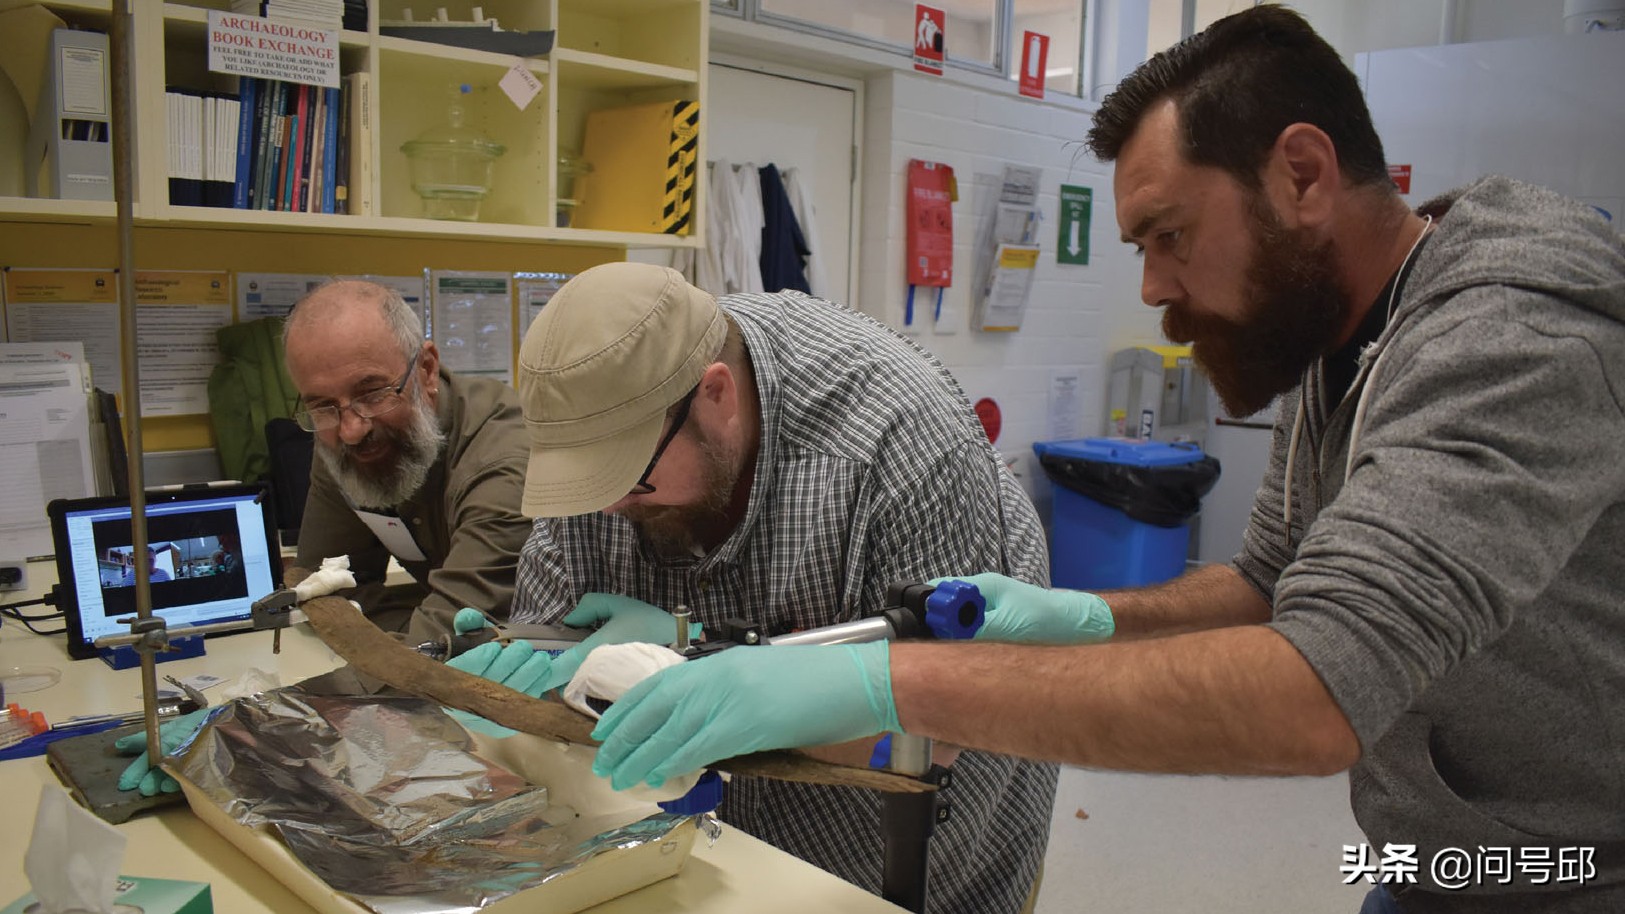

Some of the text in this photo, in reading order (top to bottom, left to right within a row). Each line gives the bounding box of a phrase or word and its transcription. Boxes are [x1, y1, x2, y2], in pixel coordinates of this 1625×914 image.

[220, 17, 328, 43] ARCHAEOLOGY
[213, 31, 335, 60] BOOK EXCHANGE
[213, 46, 335, 69] FEEL FREE TO TAKE OR ADD WHAT
[222, 55, 238, 63] YOU
[240, 57, 256, 66] LIKE
[225, 63, 259, 74] RELATED
[260, 67, 302, 80] RESOURCES
